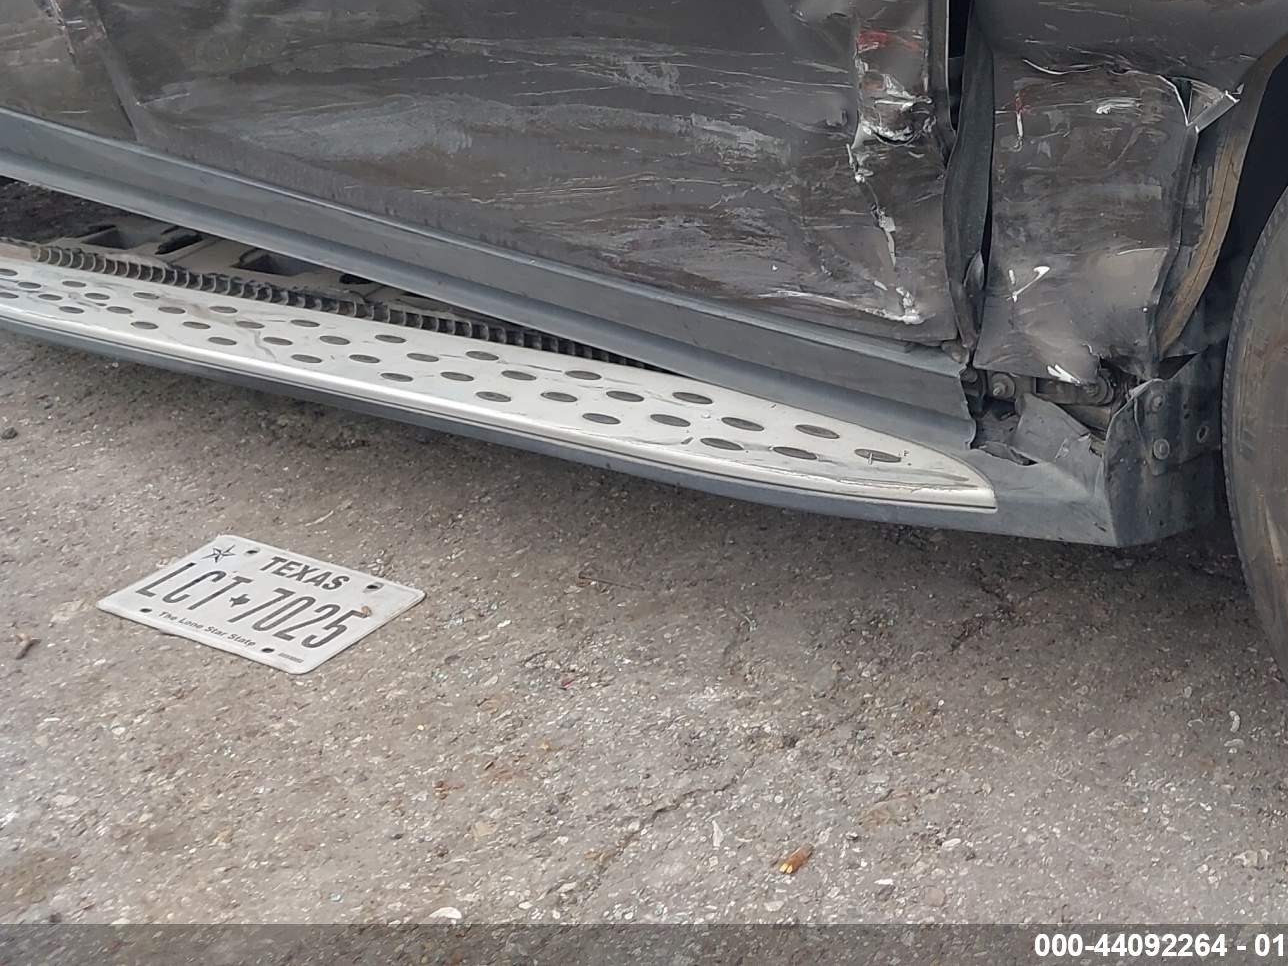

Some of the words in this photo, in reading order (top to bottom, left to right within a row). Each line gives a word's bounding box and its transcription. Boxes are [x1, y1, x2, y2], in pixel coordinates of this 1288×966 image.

[259, 556, 350, 590] TEXAS
[135, 562, 253, 611] LCT
[227, 587, 369, 649] 7025
[159, 611, 178, 621] The
[178, 617, 204, 630] Lone
[204, 626, 228, 637] Star
[227, 634, 257, 647] State
